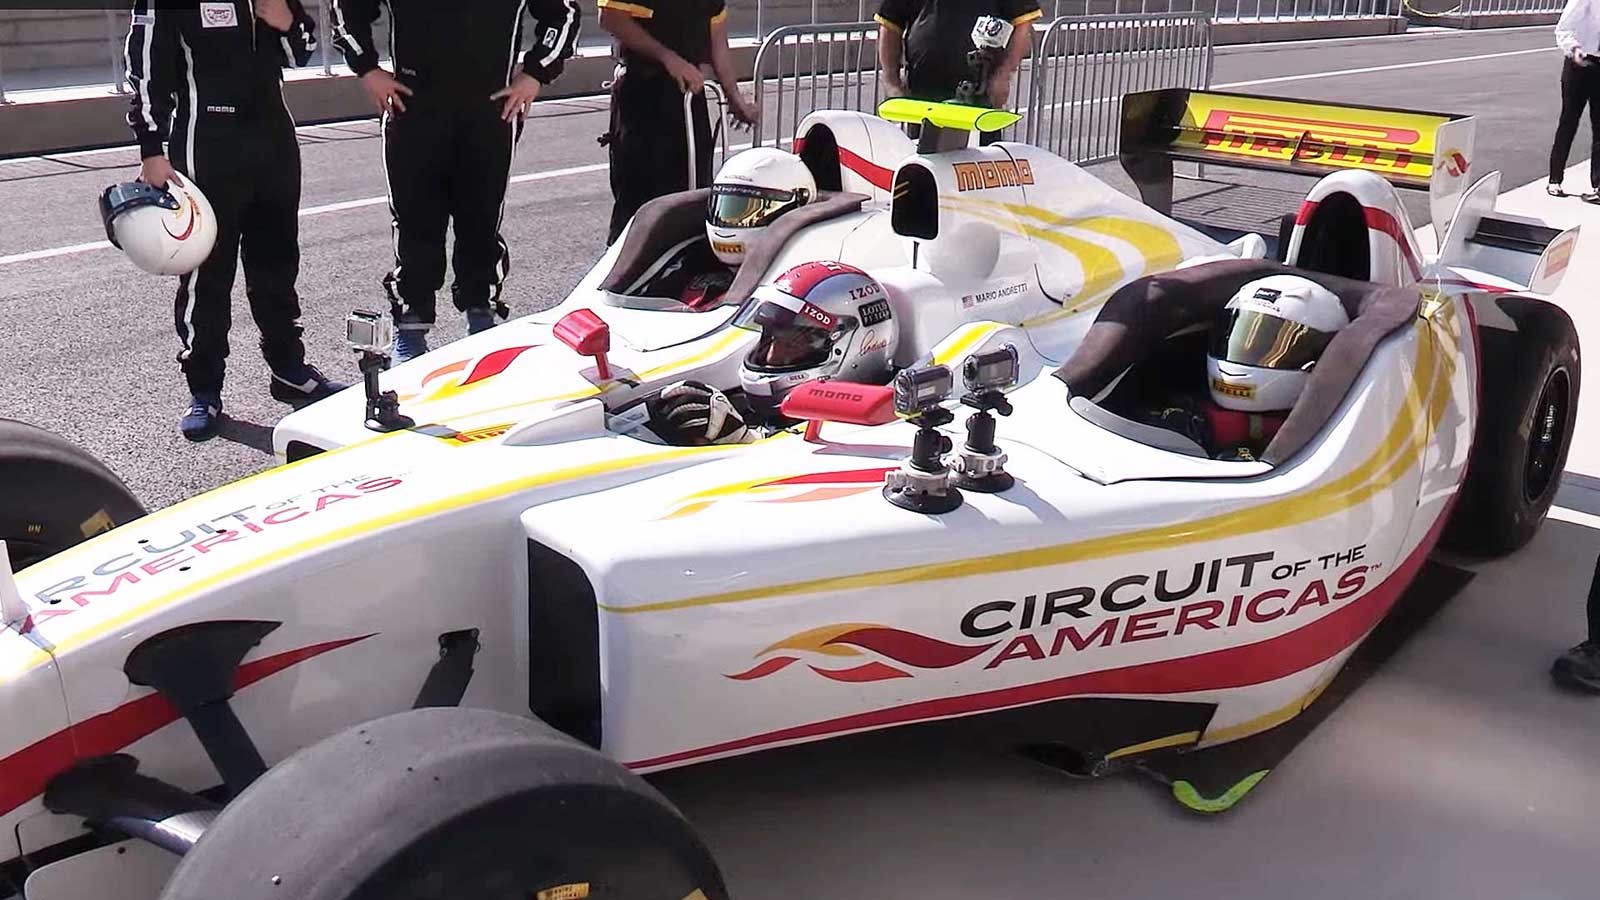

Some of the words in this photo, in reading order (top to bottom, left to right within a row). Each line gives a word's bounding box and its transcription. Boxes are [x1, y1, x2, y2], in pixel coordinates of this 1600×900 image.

[1201, 110, 1420, 168] PIRELLI
[803, 305, 832, 325] IZOD
[848, 282, 881, 300] IZOD
[975, 290, 996, 304] MARIO
[998, 283, 1028, 298] ANDRETTI
[20, 476, 403, 634] AMERICAS
[34, 505, 256, 604] RCUIT
[265, 494, 303, 510] OF
[310, 474, 372, 493] THE
[960, 551, 1275, 638] CIRCUIT
[1270, 559, 1311, 580] OF
[1318, 544, 1367, 570] THE
[983, 563, 1369, 669] AMERICAS
